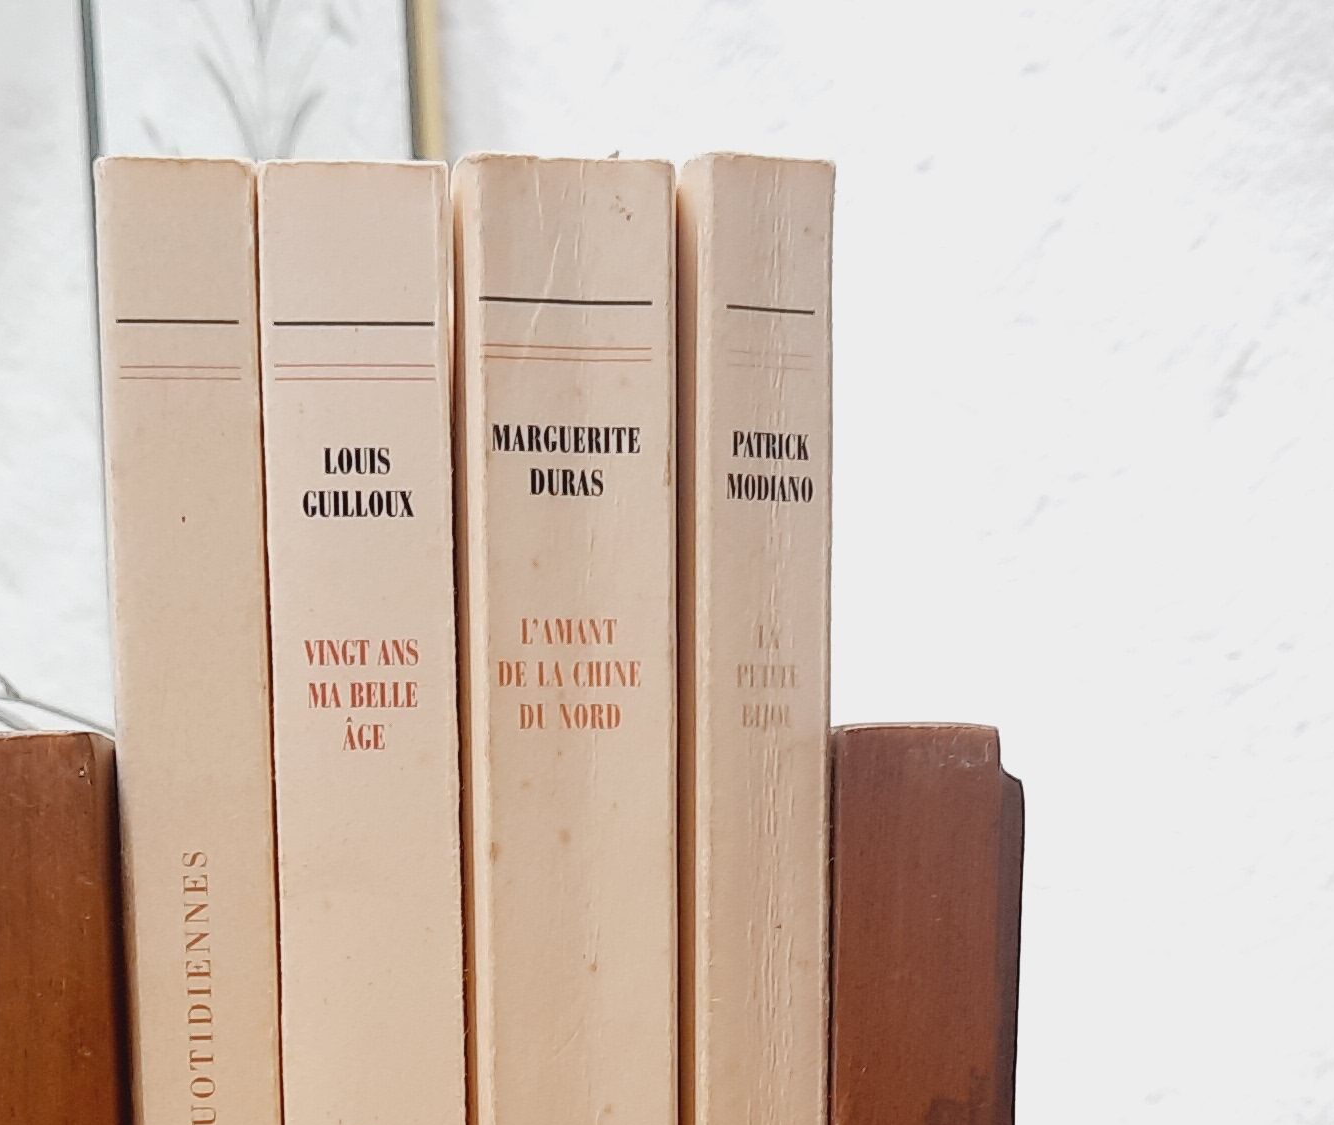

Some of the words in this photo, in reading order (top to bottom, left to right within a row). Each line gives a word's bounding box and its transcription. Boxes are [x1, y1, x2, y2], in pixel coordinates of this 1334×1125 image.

[491, 423, 641, 454] MARGUERITE
[732, 430, 809, 461] PATRICK
[324, 447, 391, 475] LOUIS
[529, 467, 604, 497] DURAS
[726, 472, 814, 503] MODIANO
[302, 490, 414, 518] GUILLOUX
[521, 617, 613, 646] L'AMANT
[304, 639, 370, 666] VINGT
[377, 639, 419, 666] ANS
[498, 660, 525, 688] DE
[538, 661, 564, 688] LA
[572, 660, 641, 688] CHINE
[308, 682, 342, 709] MA
[350, 681, 418, 709] BELLE
[519, 703, 544, 730] DU
[559, 703, 621, 730] NORD
[343, 716, 386, 751] ÂGE
